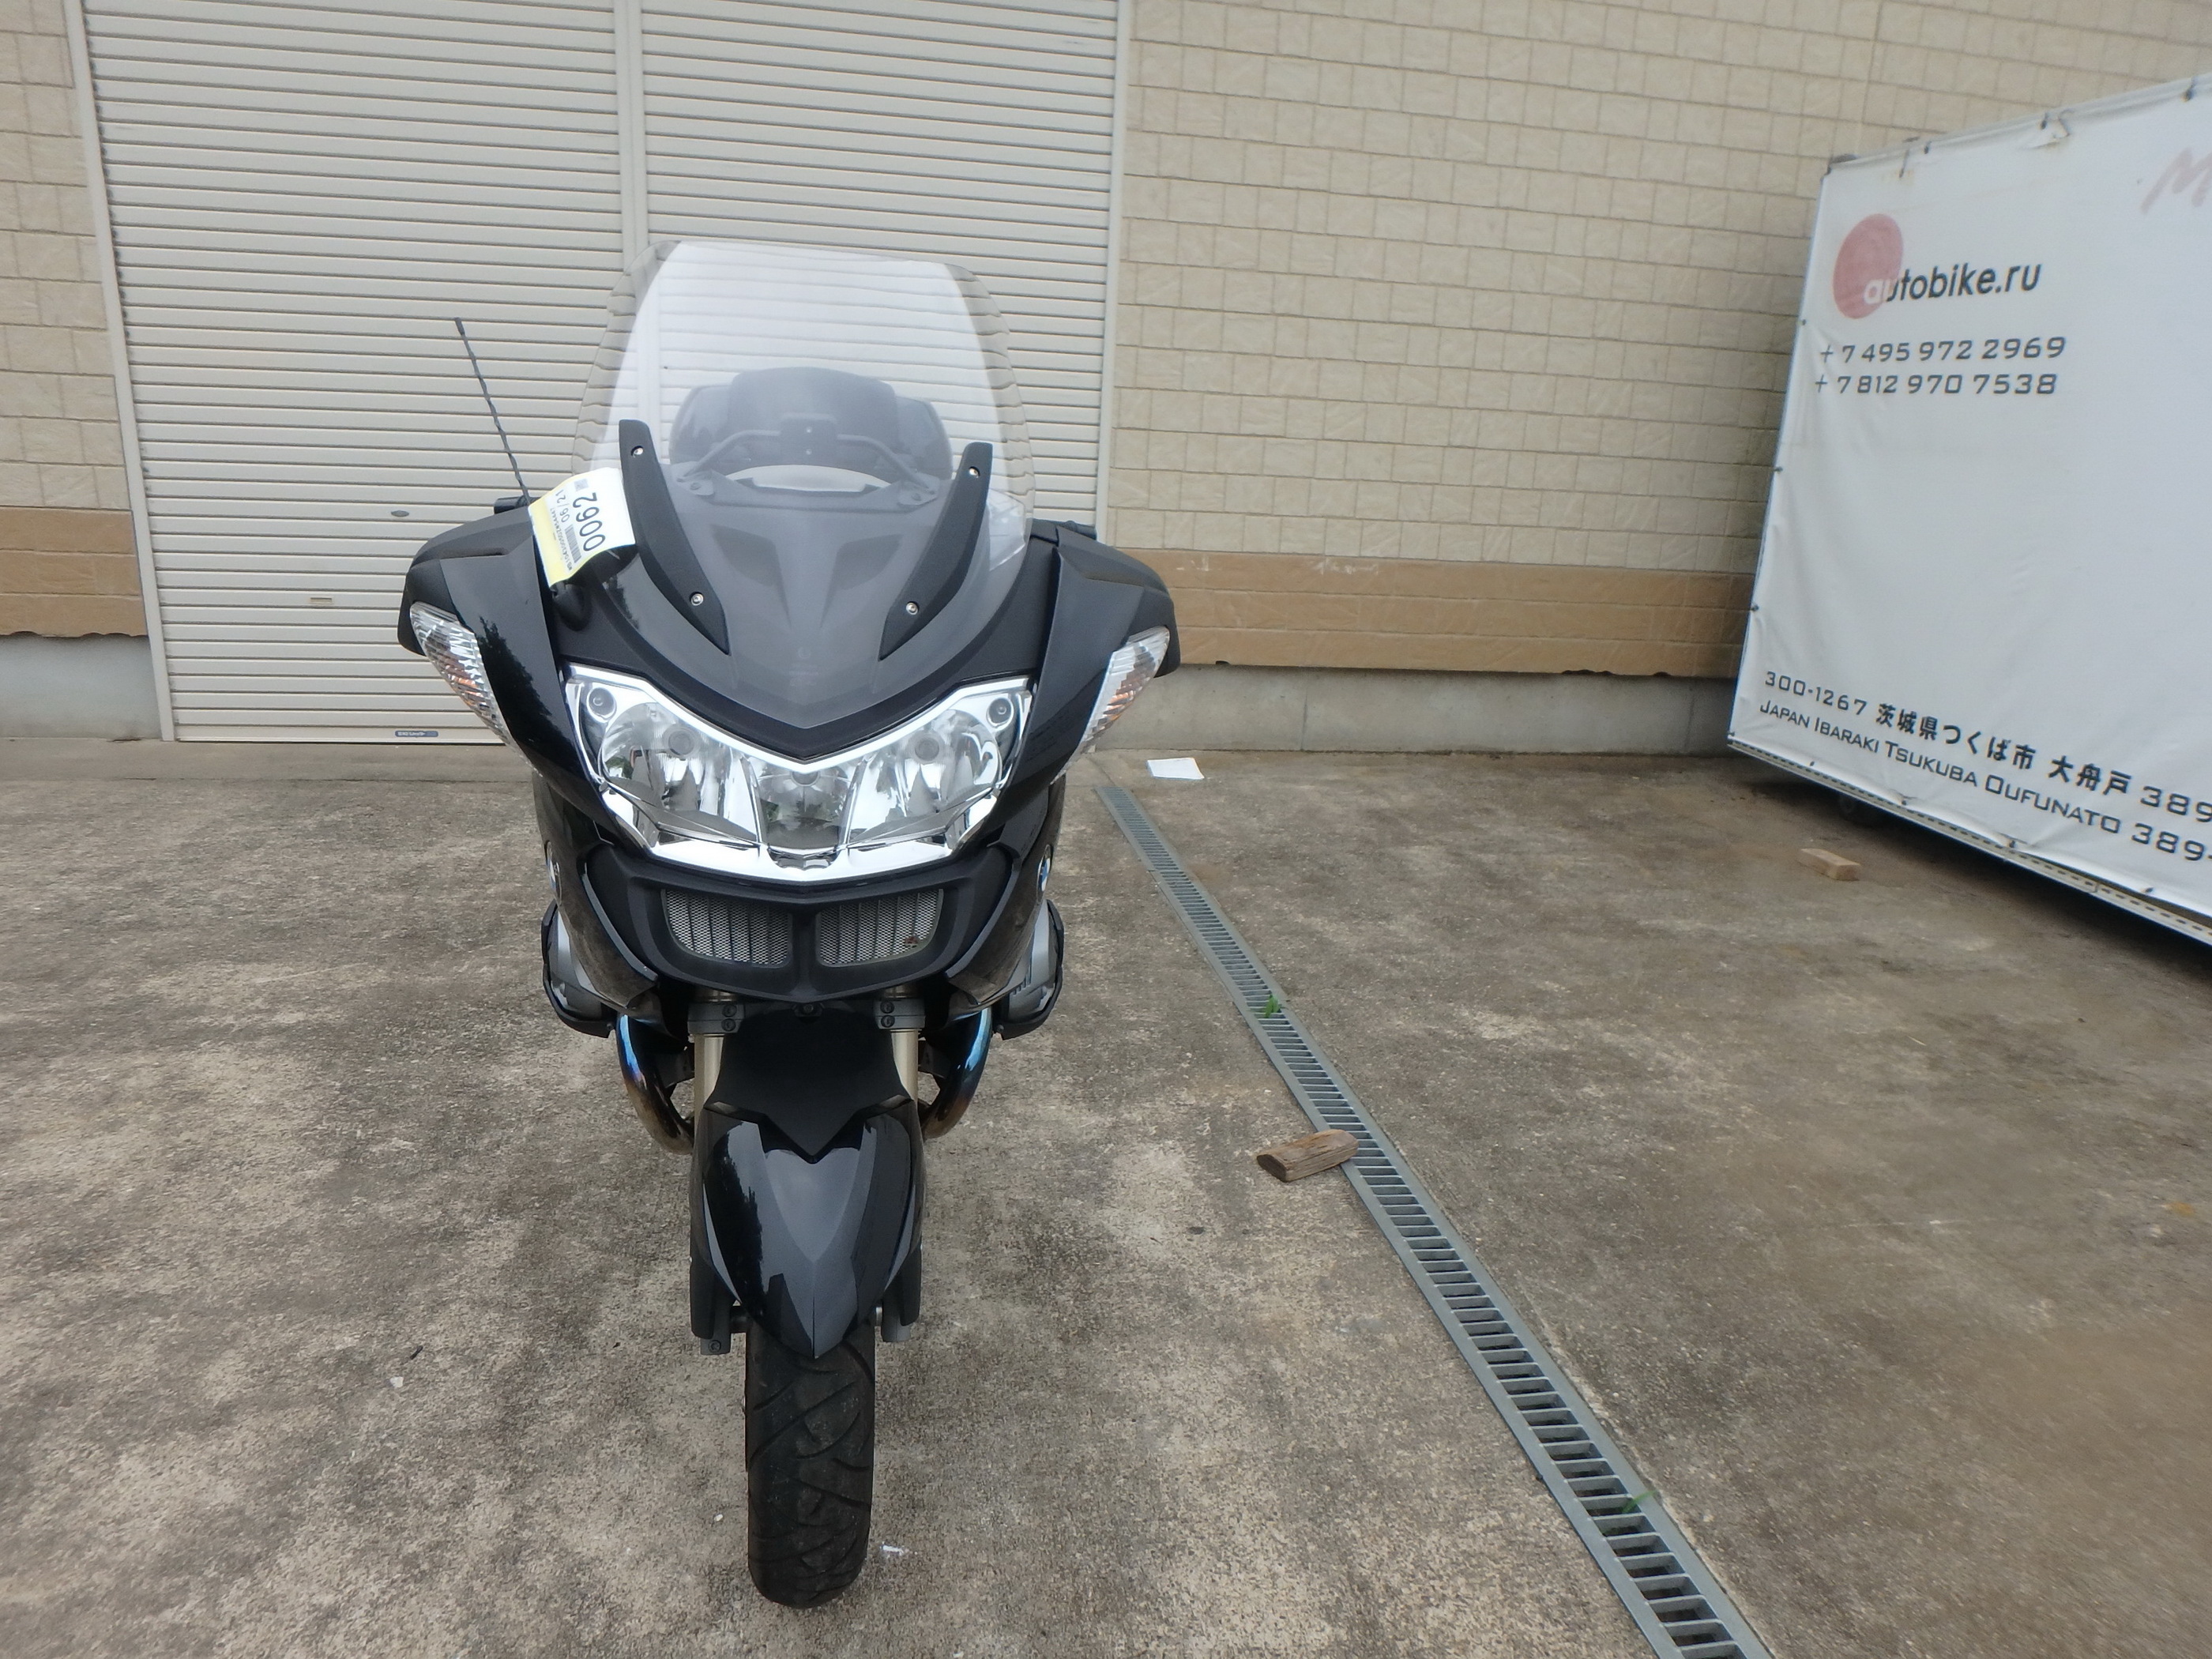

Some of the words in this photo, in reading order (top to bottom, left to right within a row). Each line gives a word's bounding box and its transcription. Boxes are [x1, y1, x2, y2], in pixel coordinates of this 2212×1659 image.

[1864, 262, 2041, 305] autobike.ru
[1919, 340, 1972, 361] 972
[1981, 337, 2066, 359] 2969
[1908, 374, 1962, 393] 970
[1973, 374, 2056, 393] 7538
[573, 492, 605, 551] 0062
[1765, 672, 1867, 715] 300-1267
[1875, 703, 2036, 769] 茨城県つくば市
